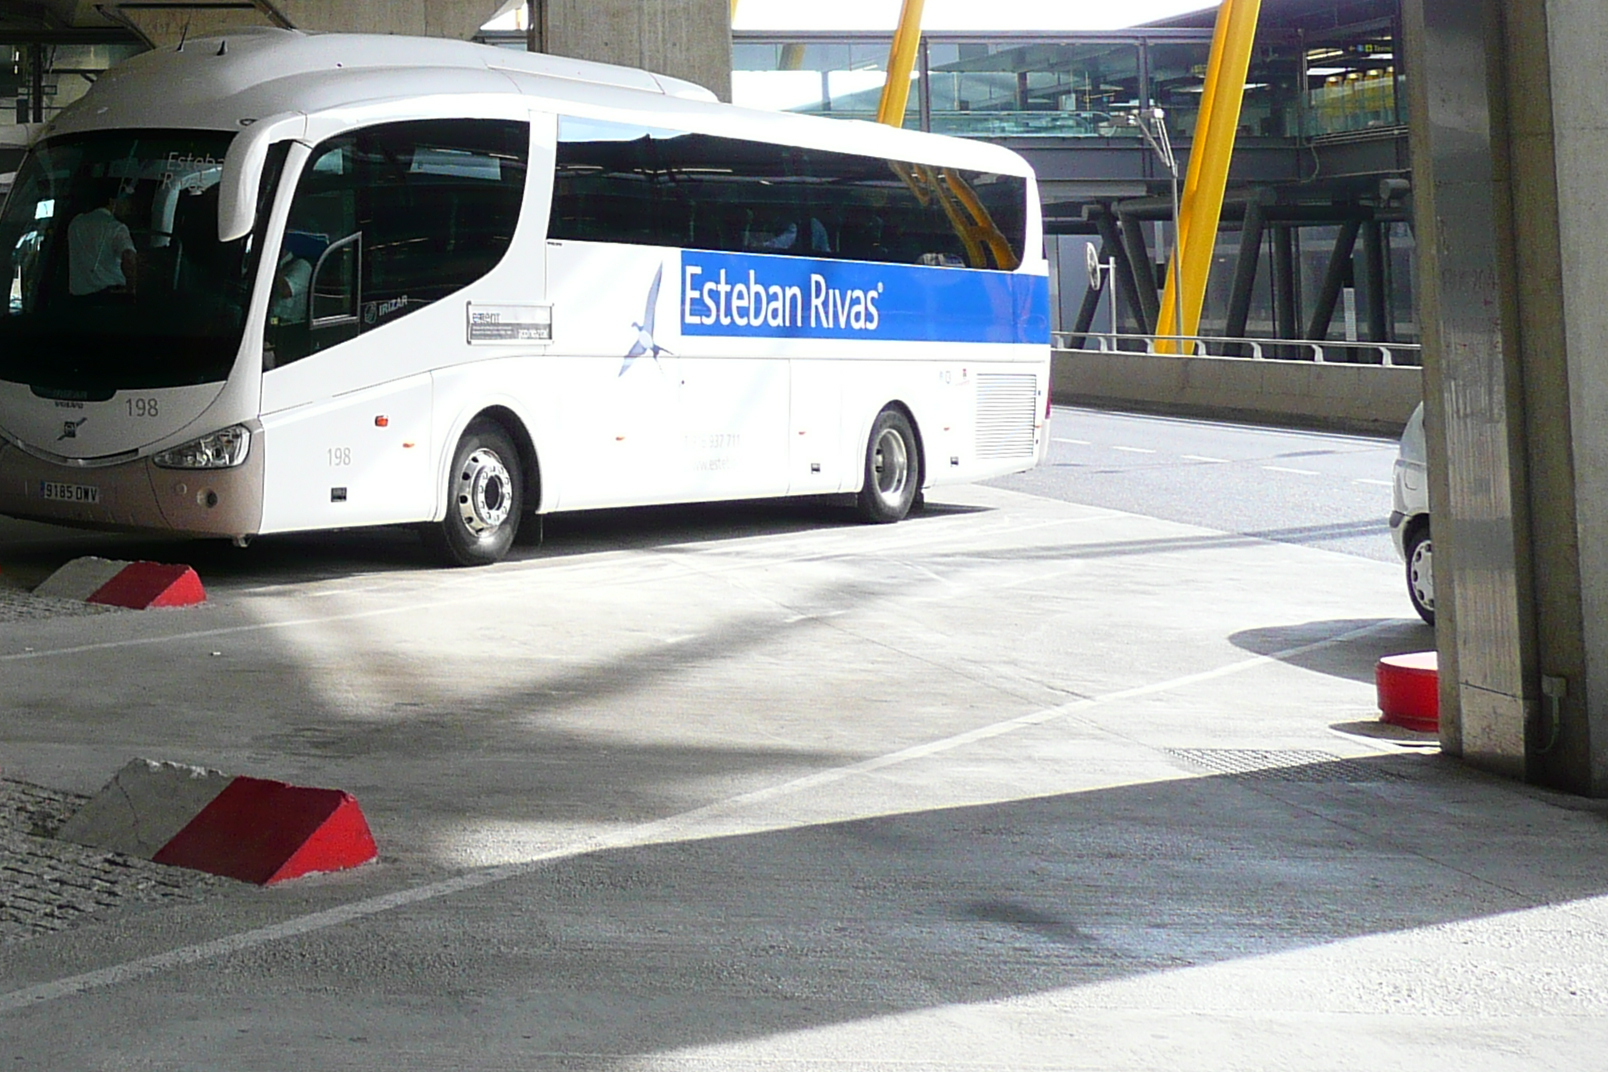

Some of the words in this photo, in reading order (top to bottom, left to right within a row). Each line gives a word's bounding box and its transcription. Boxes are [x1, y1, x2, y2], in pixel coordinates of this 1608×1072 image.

[379, 294, 408, 316] IRIZAR
[684, 264, 803, 328] Esteban
[125, 398, 159, 417] 198
[327, 447, 351, 466] 198
[46, 483, 73, 499] 9185
